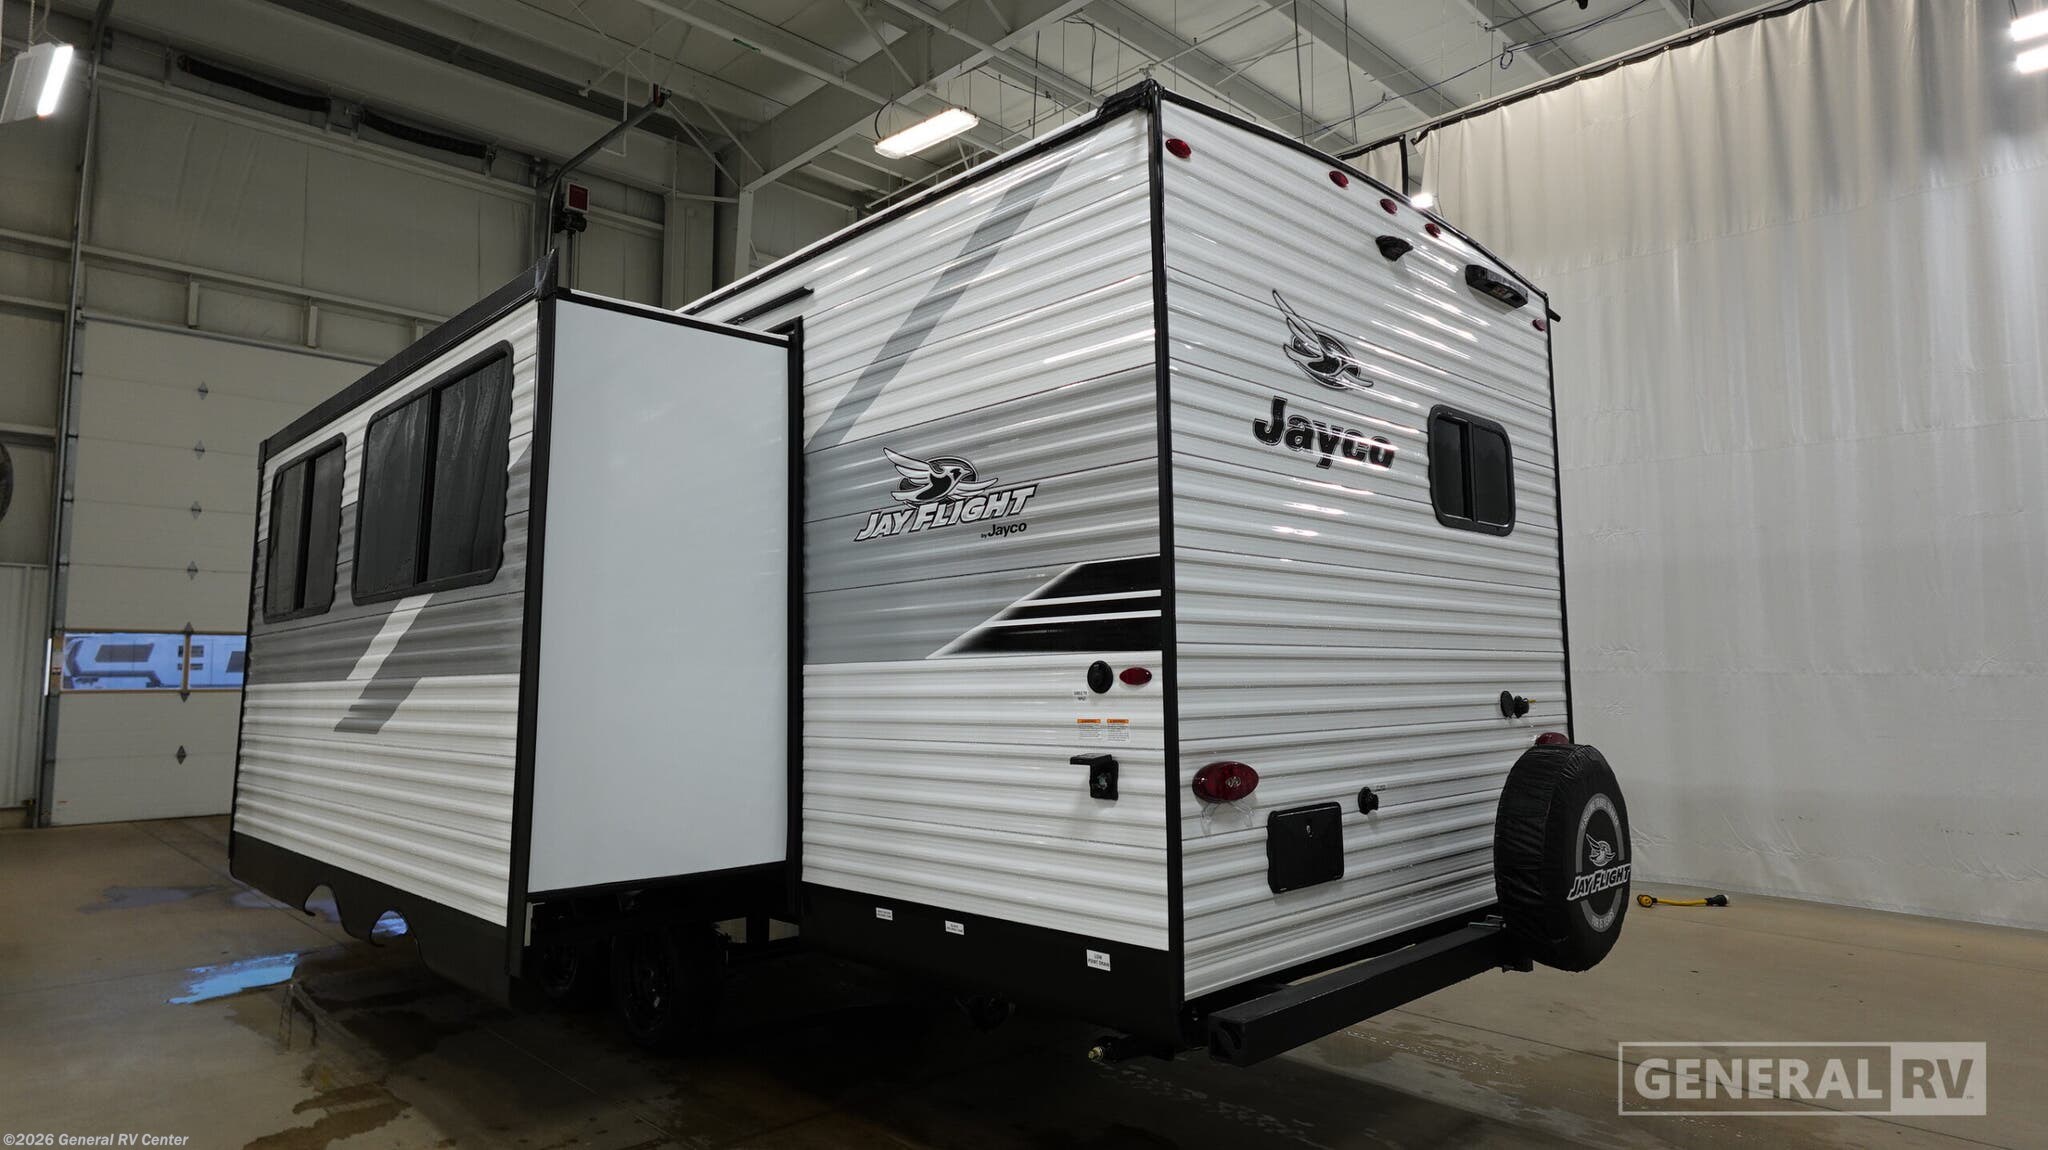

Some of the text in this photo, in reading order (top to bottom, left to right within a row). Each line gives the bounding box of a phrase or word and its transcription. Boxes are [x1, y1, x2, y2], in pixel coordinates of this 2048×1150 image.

[1252, 395, 1395, 469] Jayco
[854, 483, 1039, 542] JAY FLIGHT
[988, 522, 1027, 538] Jayco
[1566, 863, 1631, 901] JAY FLIGHT
